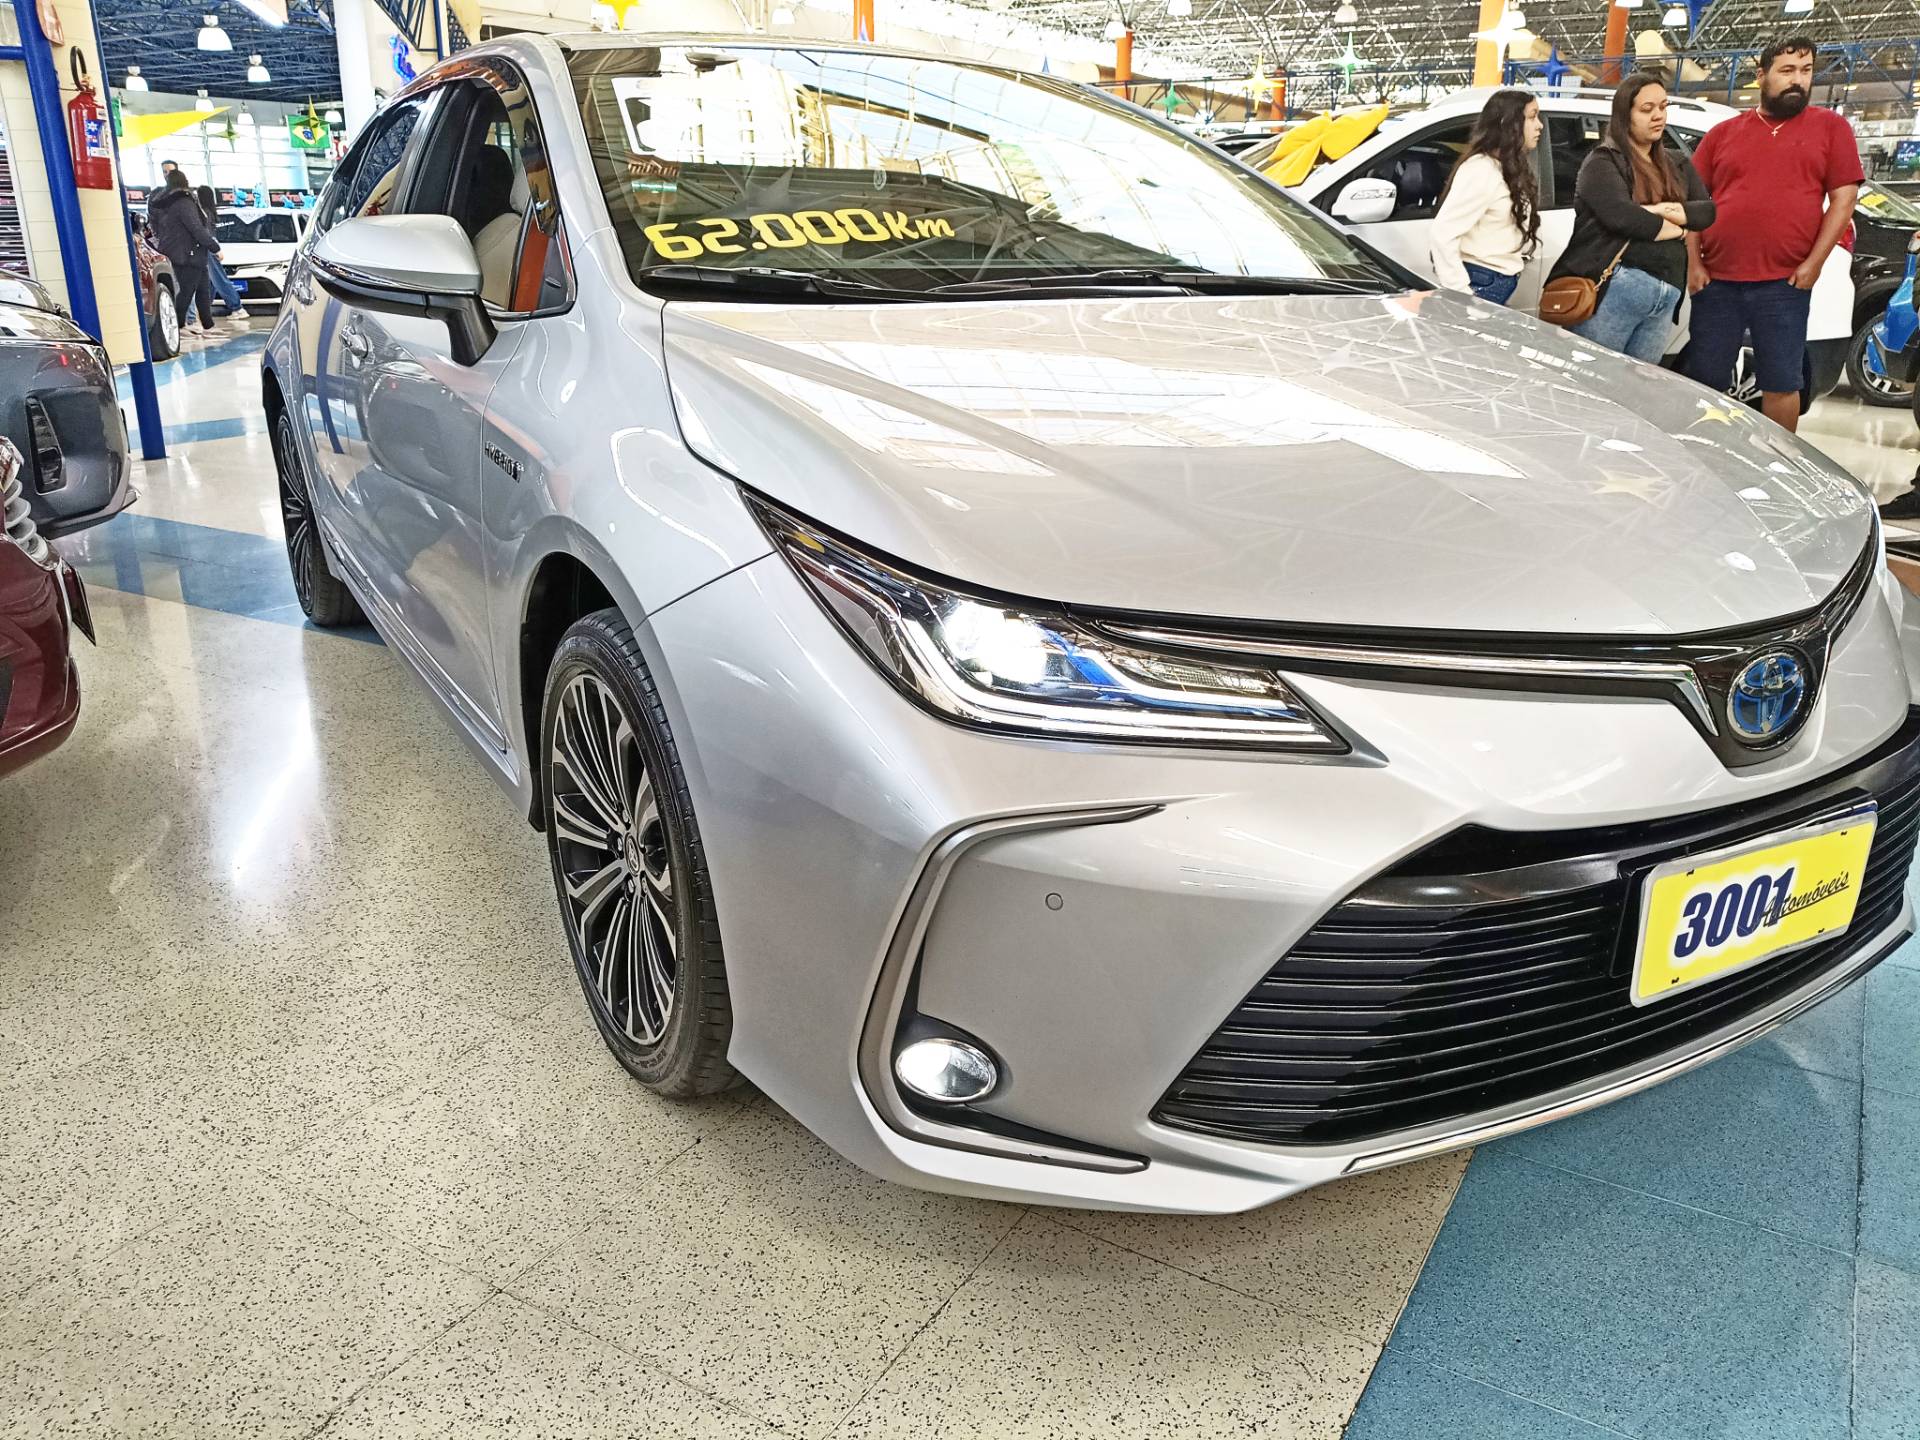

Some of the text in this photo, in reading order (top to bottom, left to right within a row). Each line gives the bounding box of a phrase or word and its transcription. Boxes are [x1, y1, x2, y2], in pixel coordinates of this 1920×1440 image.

[484, 441, 513, 476] HYBRID
[1674, 867, 1849, 958] 3001 Automóveis
